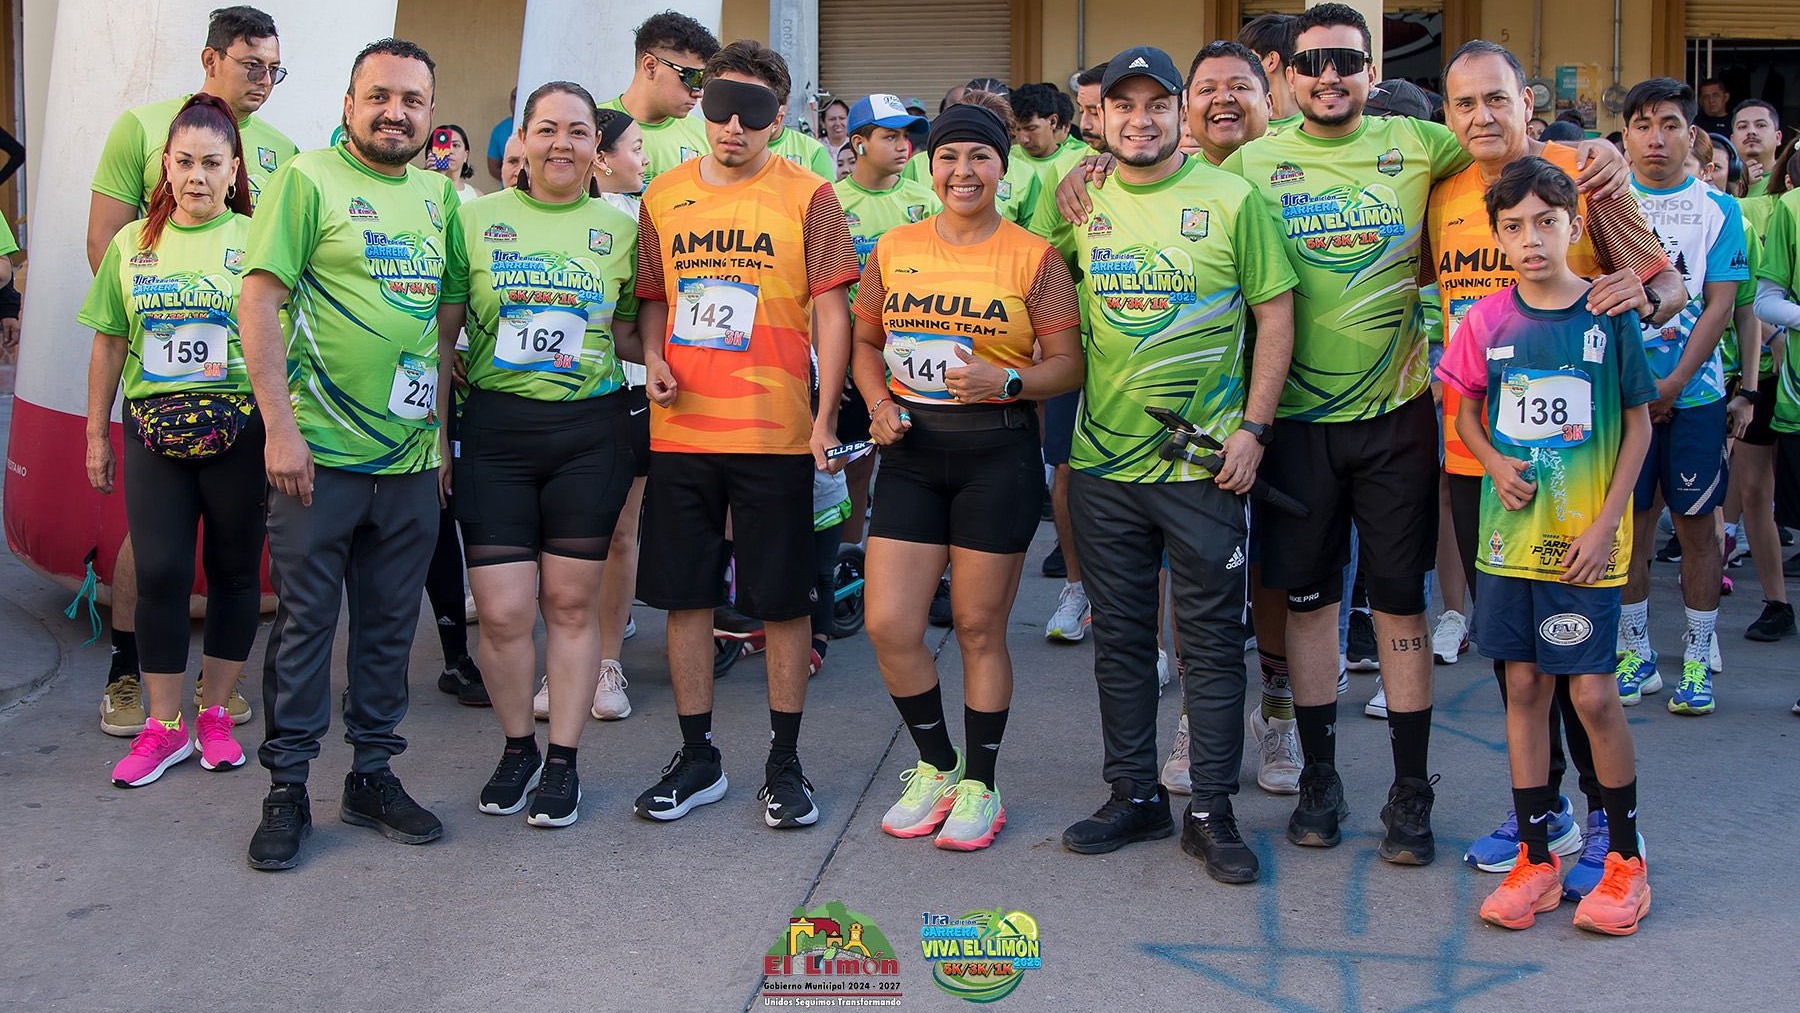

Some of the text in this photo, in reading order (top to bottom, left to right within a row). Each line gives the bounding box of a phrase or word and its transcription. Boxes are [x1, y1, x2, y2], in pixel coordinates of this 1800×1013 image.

[1501, 28, 1510, 42] 5
[1281, 193, 1310, 206] 1ra
[1640, 200, 1694, 210] ONSO
[1282, 202, 1339, 218] CARRERA
[1283, 204, 1403, 238] VIVA EL LIMÓN
[364, 230, 387, 246] 1ra
[672, 229, 774, 258] AMULA
[1306, 232, 1379, 250] 5K/3K/1K
[365, 246, 410, 258] CARRERA
[492, 249, 520, 262] 1ra
[1091, 247, 1112, 260] 1ra
[366, 258, 398, 278] VIVA
[400, 260, 418, 278] EL
[491, 262, 546, 272] CARRERA
[730, 259, 762, 270] TEAM
[1090, 262, 1136, 273] CARRERA
[1440, 248, 1514, 275] AMUL
[133, 274, 157, 286] 1ra
[490, 270, 604, 293] VIVA EL LIMÓN
[1122, 274, 1141, 293] EL
[1144, 270, 1196, 294] LIMÓN
[1496, 278, 1518, 288] TEA
[132, 284, 178, 296] CARRERA
[509, 290, 578, 304] 5K/3K/1K
[1170, 292, 1196, 304] 2025
[164, 292, 183, 308] EL
[185, 290, 233, 313] LIMÓN
[884, 292, 1008, 322] AMULA
[690, 303, 734, 330] 142
[890, 319, 996, 336] RUNNING TEAM
[517, 328, 565, 353] 162
[724, 330, 744, 346] 3K
[163, 340, 208, 364] 159
[554, 353, 574, 368] 3K
[204, 362, 222, 378] 3K
[903, 356, 947, 383] 141
[404, 380, 434, 408] 223
[1517, 396, 1568, 425] 138
[1562, 424, 1584, 442] 3K
[1303, 592, 1320, 602] PRO
